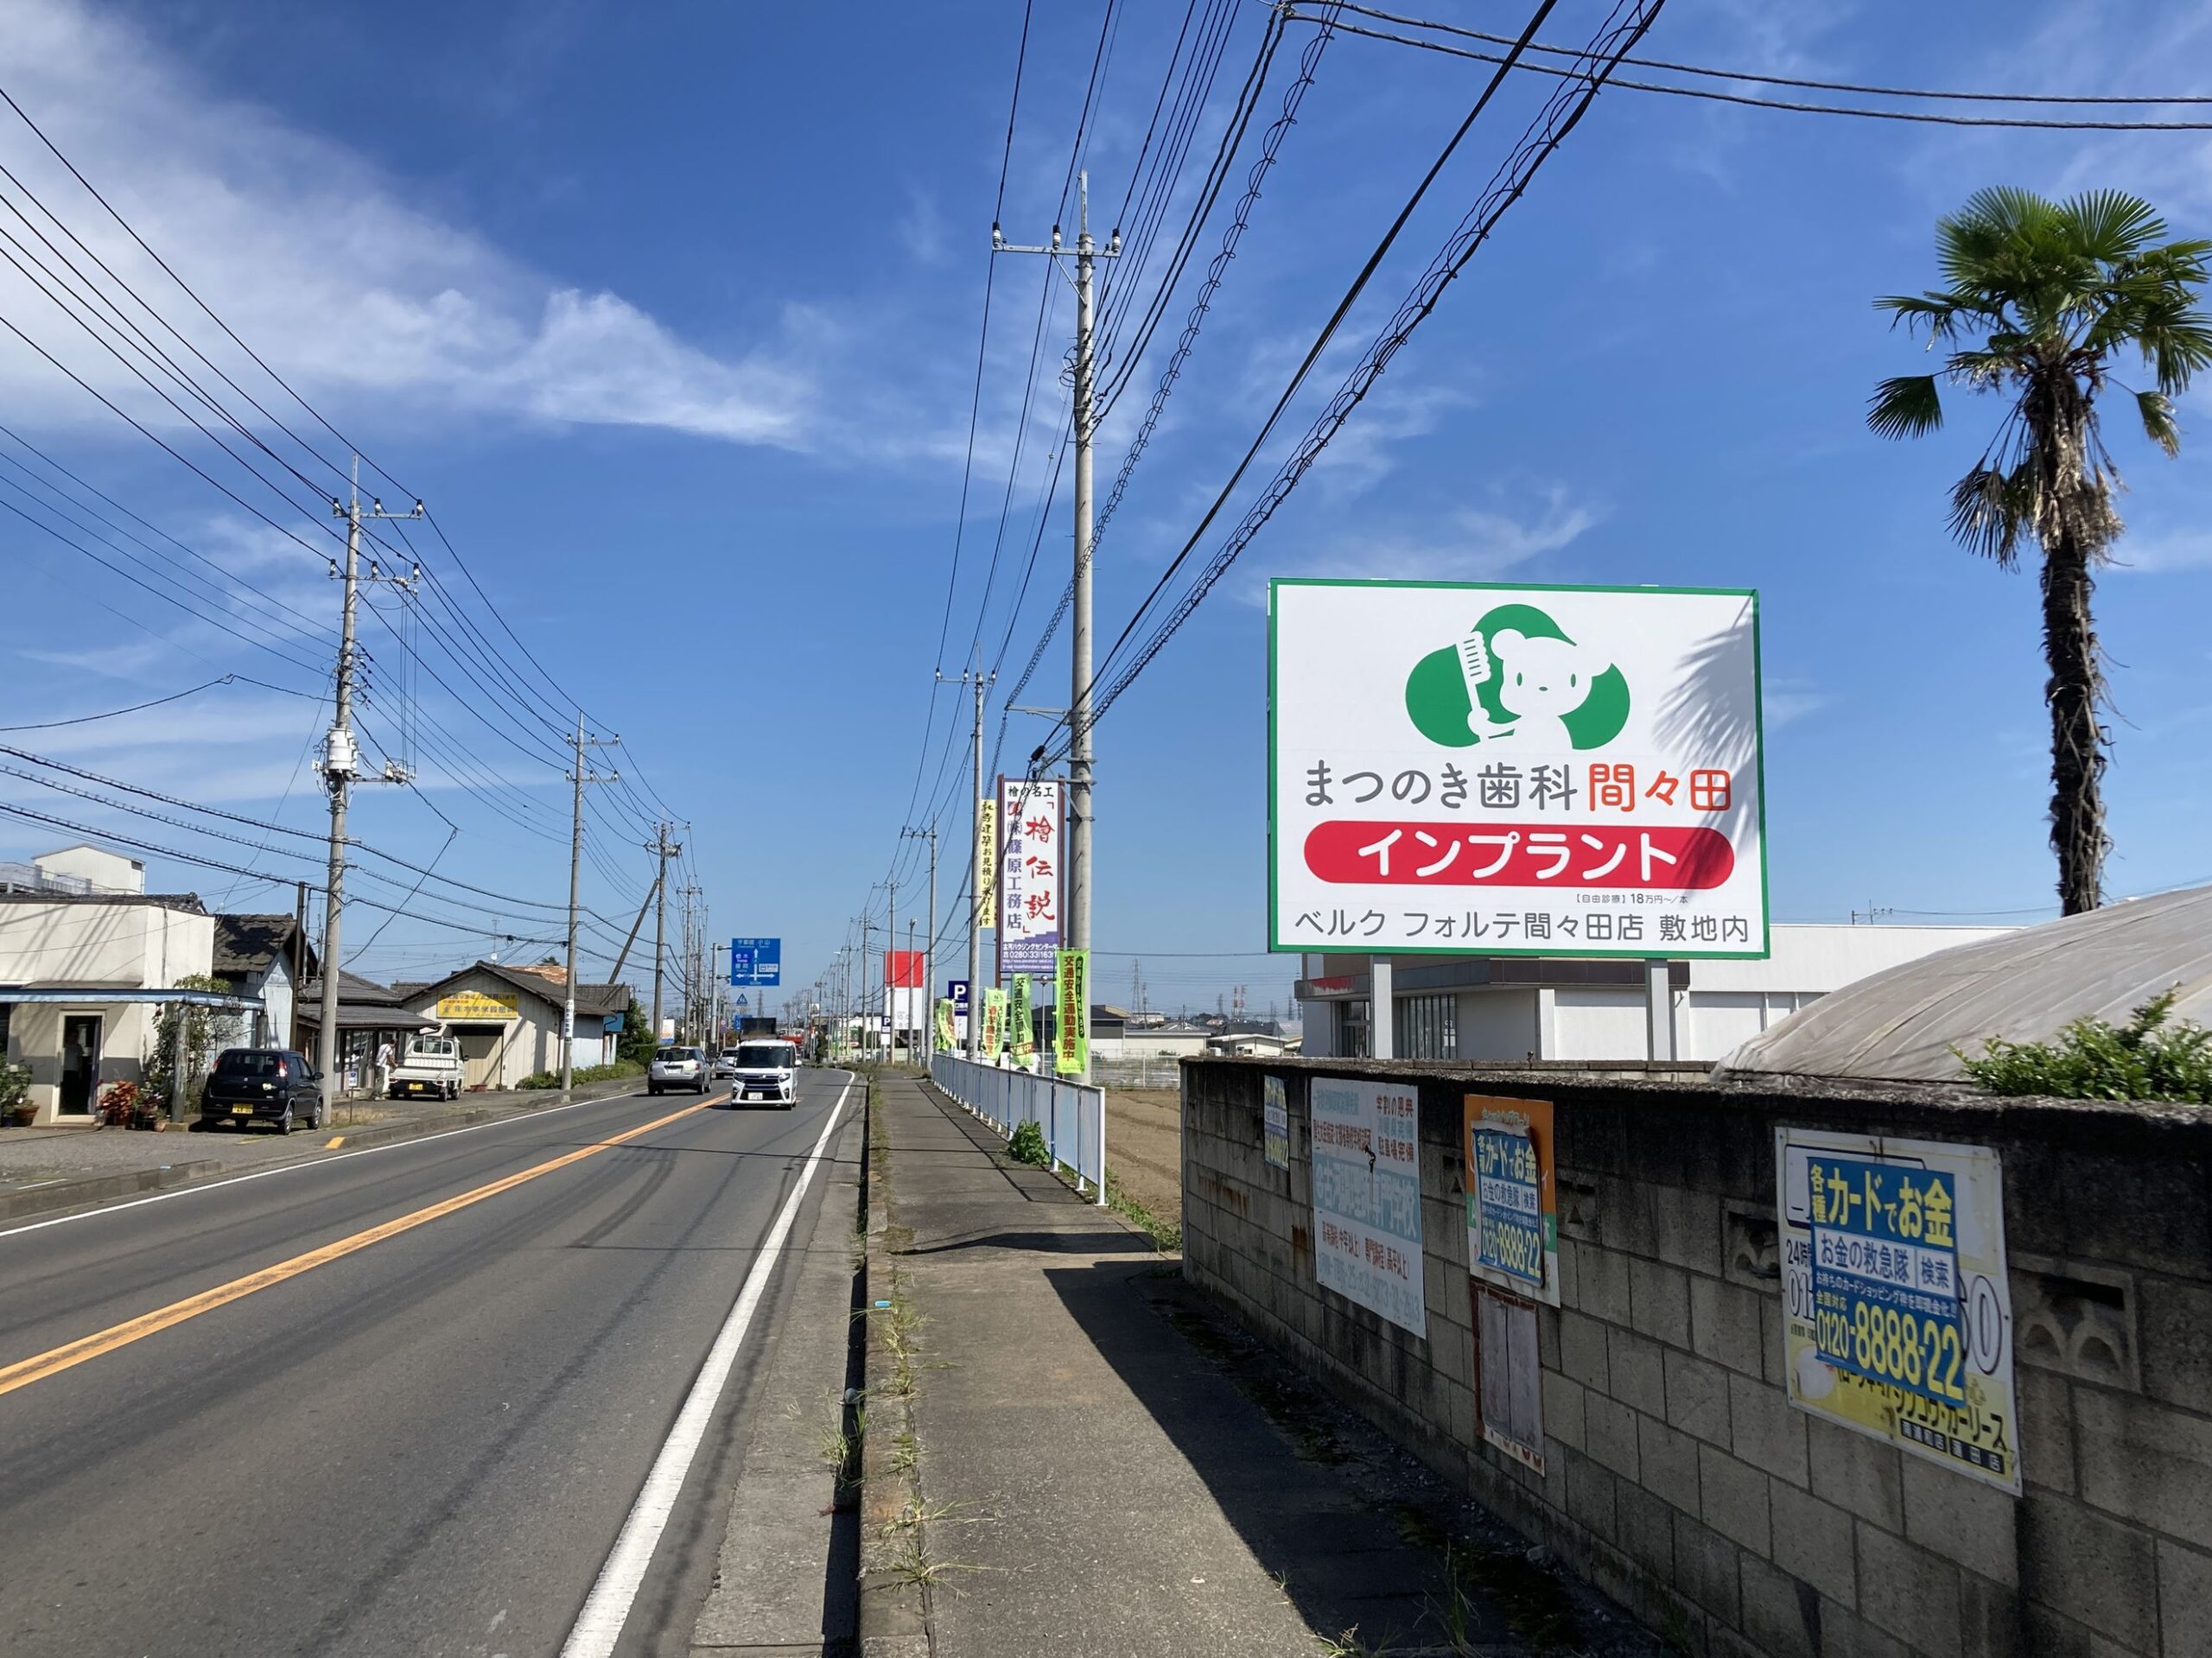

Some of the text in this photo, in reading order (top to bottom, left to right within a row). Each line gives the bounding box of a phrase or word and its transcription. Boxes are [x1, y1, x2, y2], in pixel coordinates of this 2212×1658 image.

[1358, 829, 1677, 881] インプラント
[1295, 909, 1749, 943] ベルク フォルテ間々田店 敷地内
[954, 985, 967, 1000] P
[1063, 956, 1077, 1061] 交通安全運動実施中
[1377, 1136, 1414, 1162] 駐車場完備
[1482, 1220, 1541, 1277] 0120-8888-22
[1821, 1235, 1910, 1280] お金の救急隊
[1922, 1260, 1950, 1289] 検索
[1816, 1288, 1847, 1311] 全国対応
[1816, 1300, 1963, 1401] 0120-8888-22
